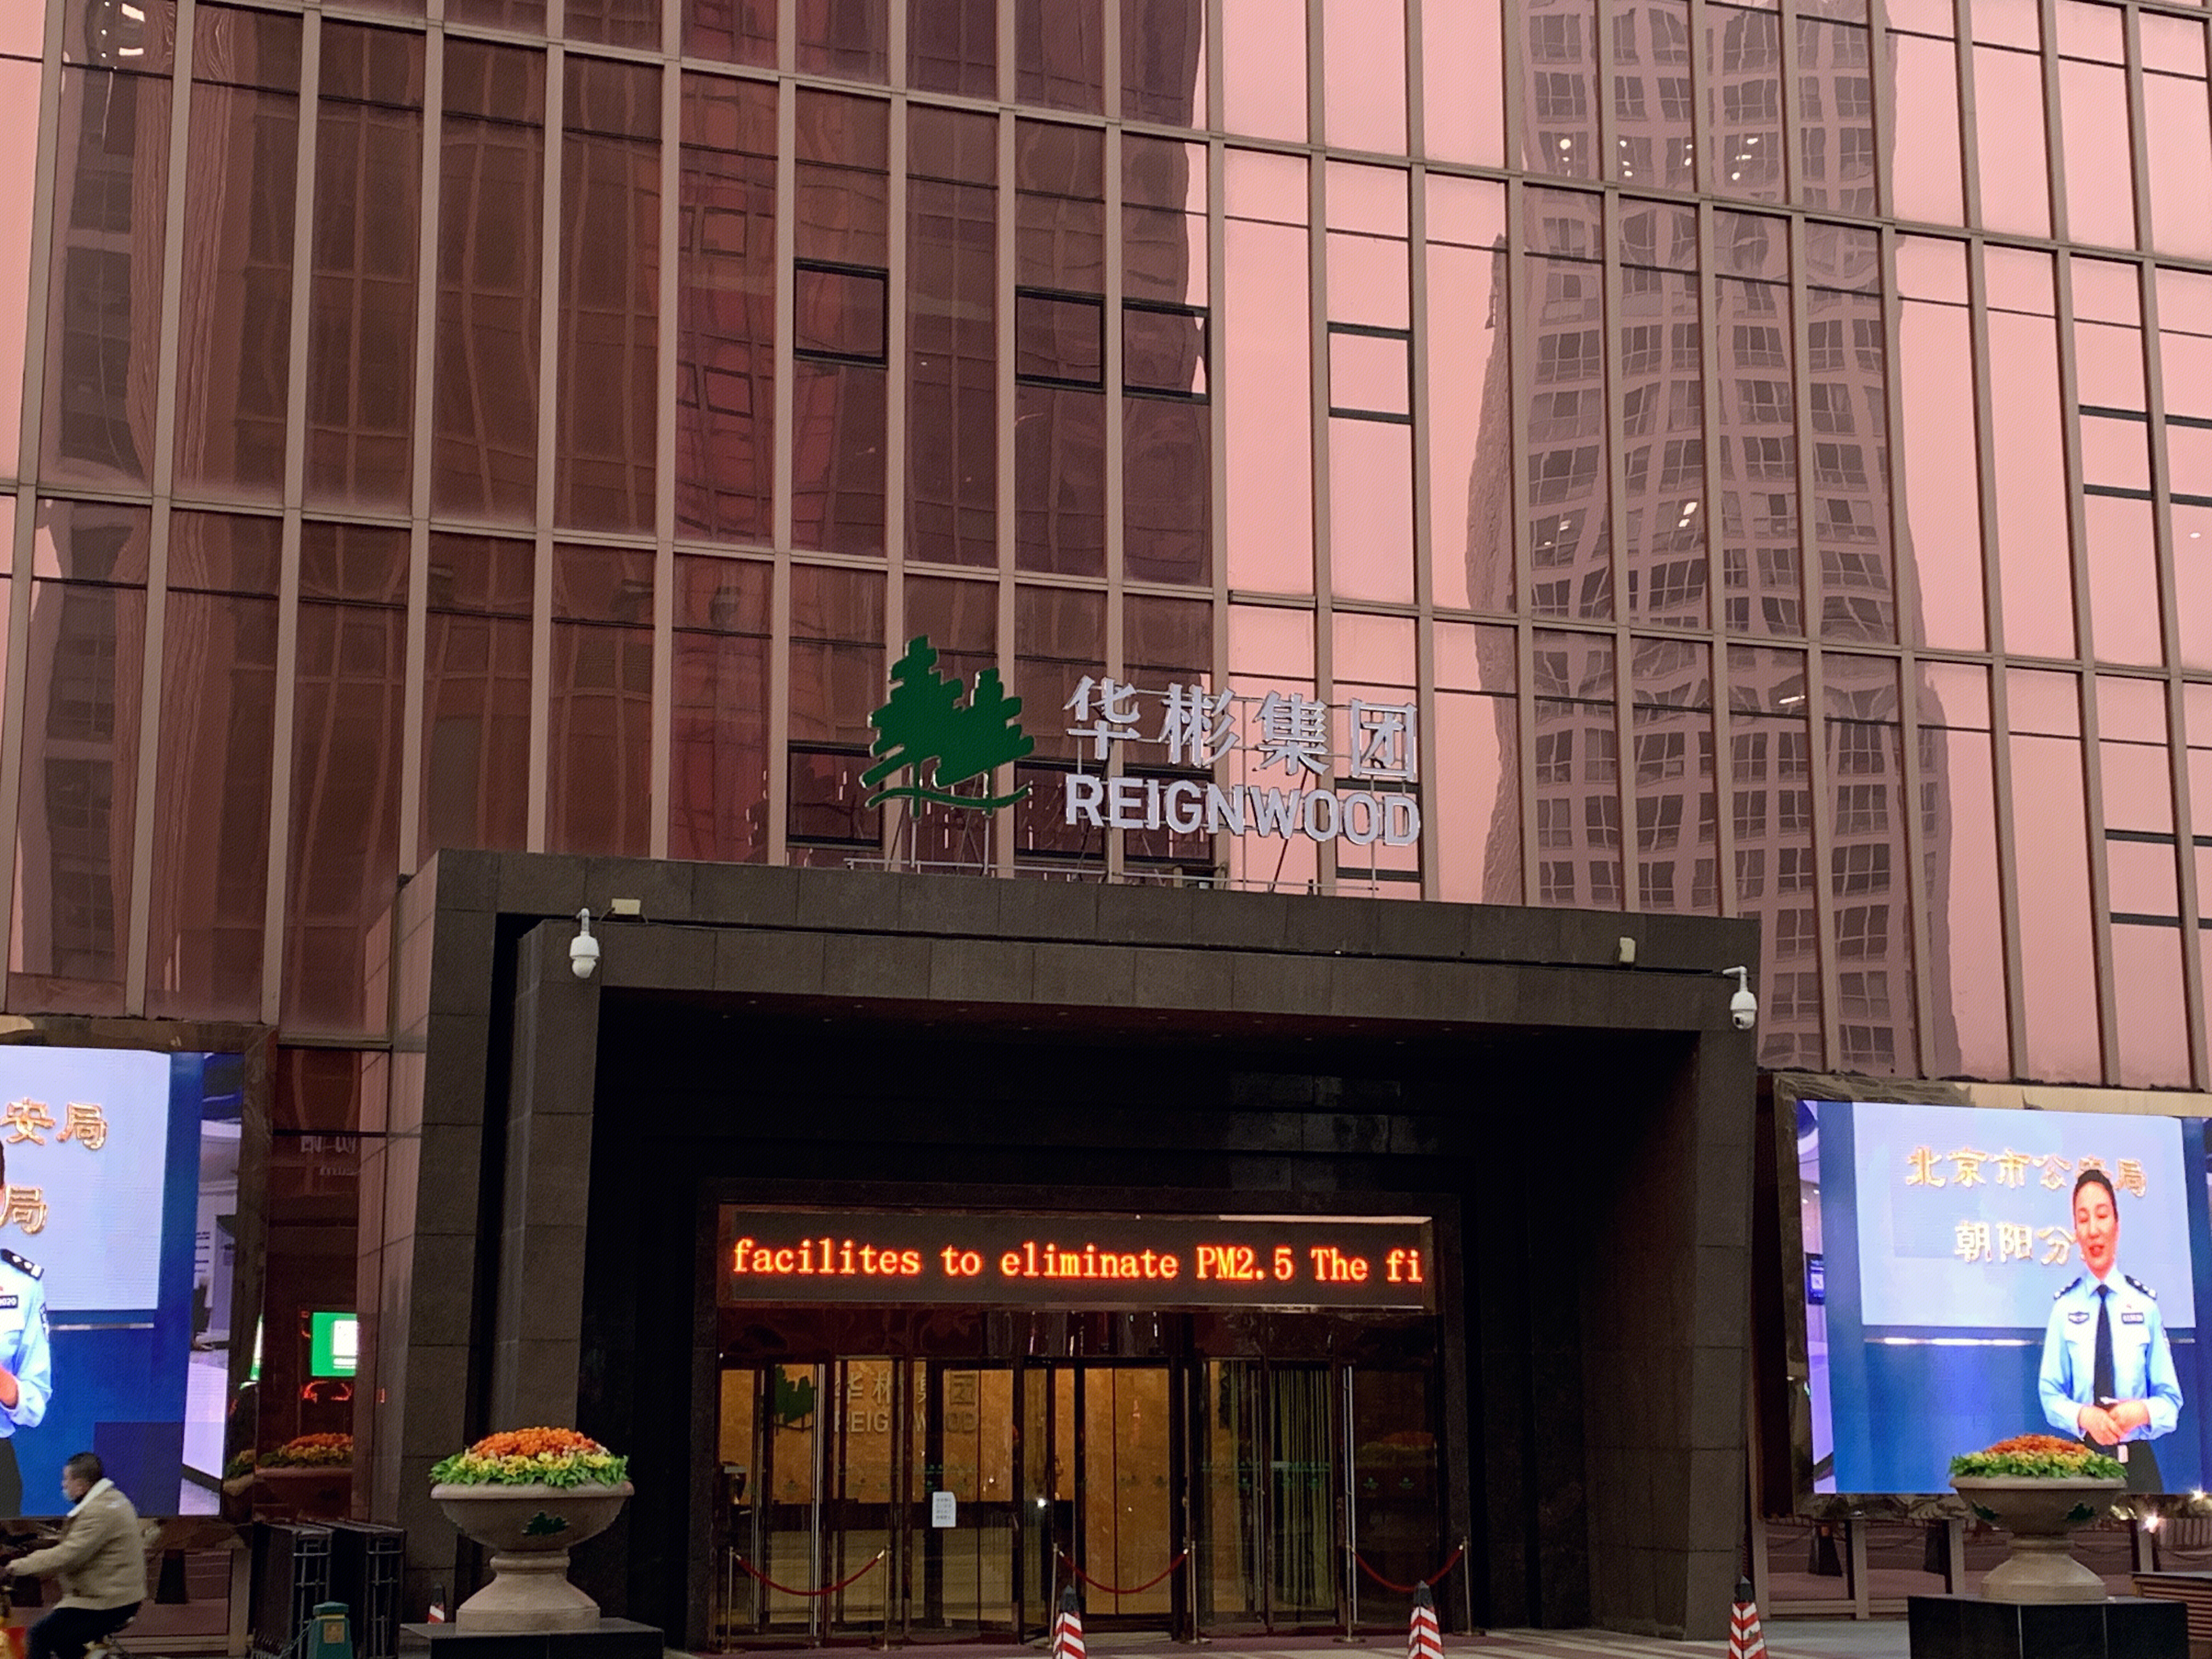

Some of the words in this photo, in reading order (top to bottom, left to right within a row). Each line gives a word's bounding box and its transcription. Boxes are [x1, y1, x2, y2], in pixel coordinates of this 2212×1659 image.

[1063, 675, 1417, 782] 华彬集团
[1065, 774, 1421, 847] REIGNWOOD
[0, 1184, 48, 1234] 局
[733, 1238, 922, 1275] facilites
[940, 1245, 982, 1277] to
[1000, 1241, 1178, 1279] eliminate
[1311, 1247, 1369, 1282] The
[1386, 1249, 1423, 1283] fi
[1954, 1220, 2080, 1265] 朝阳分
